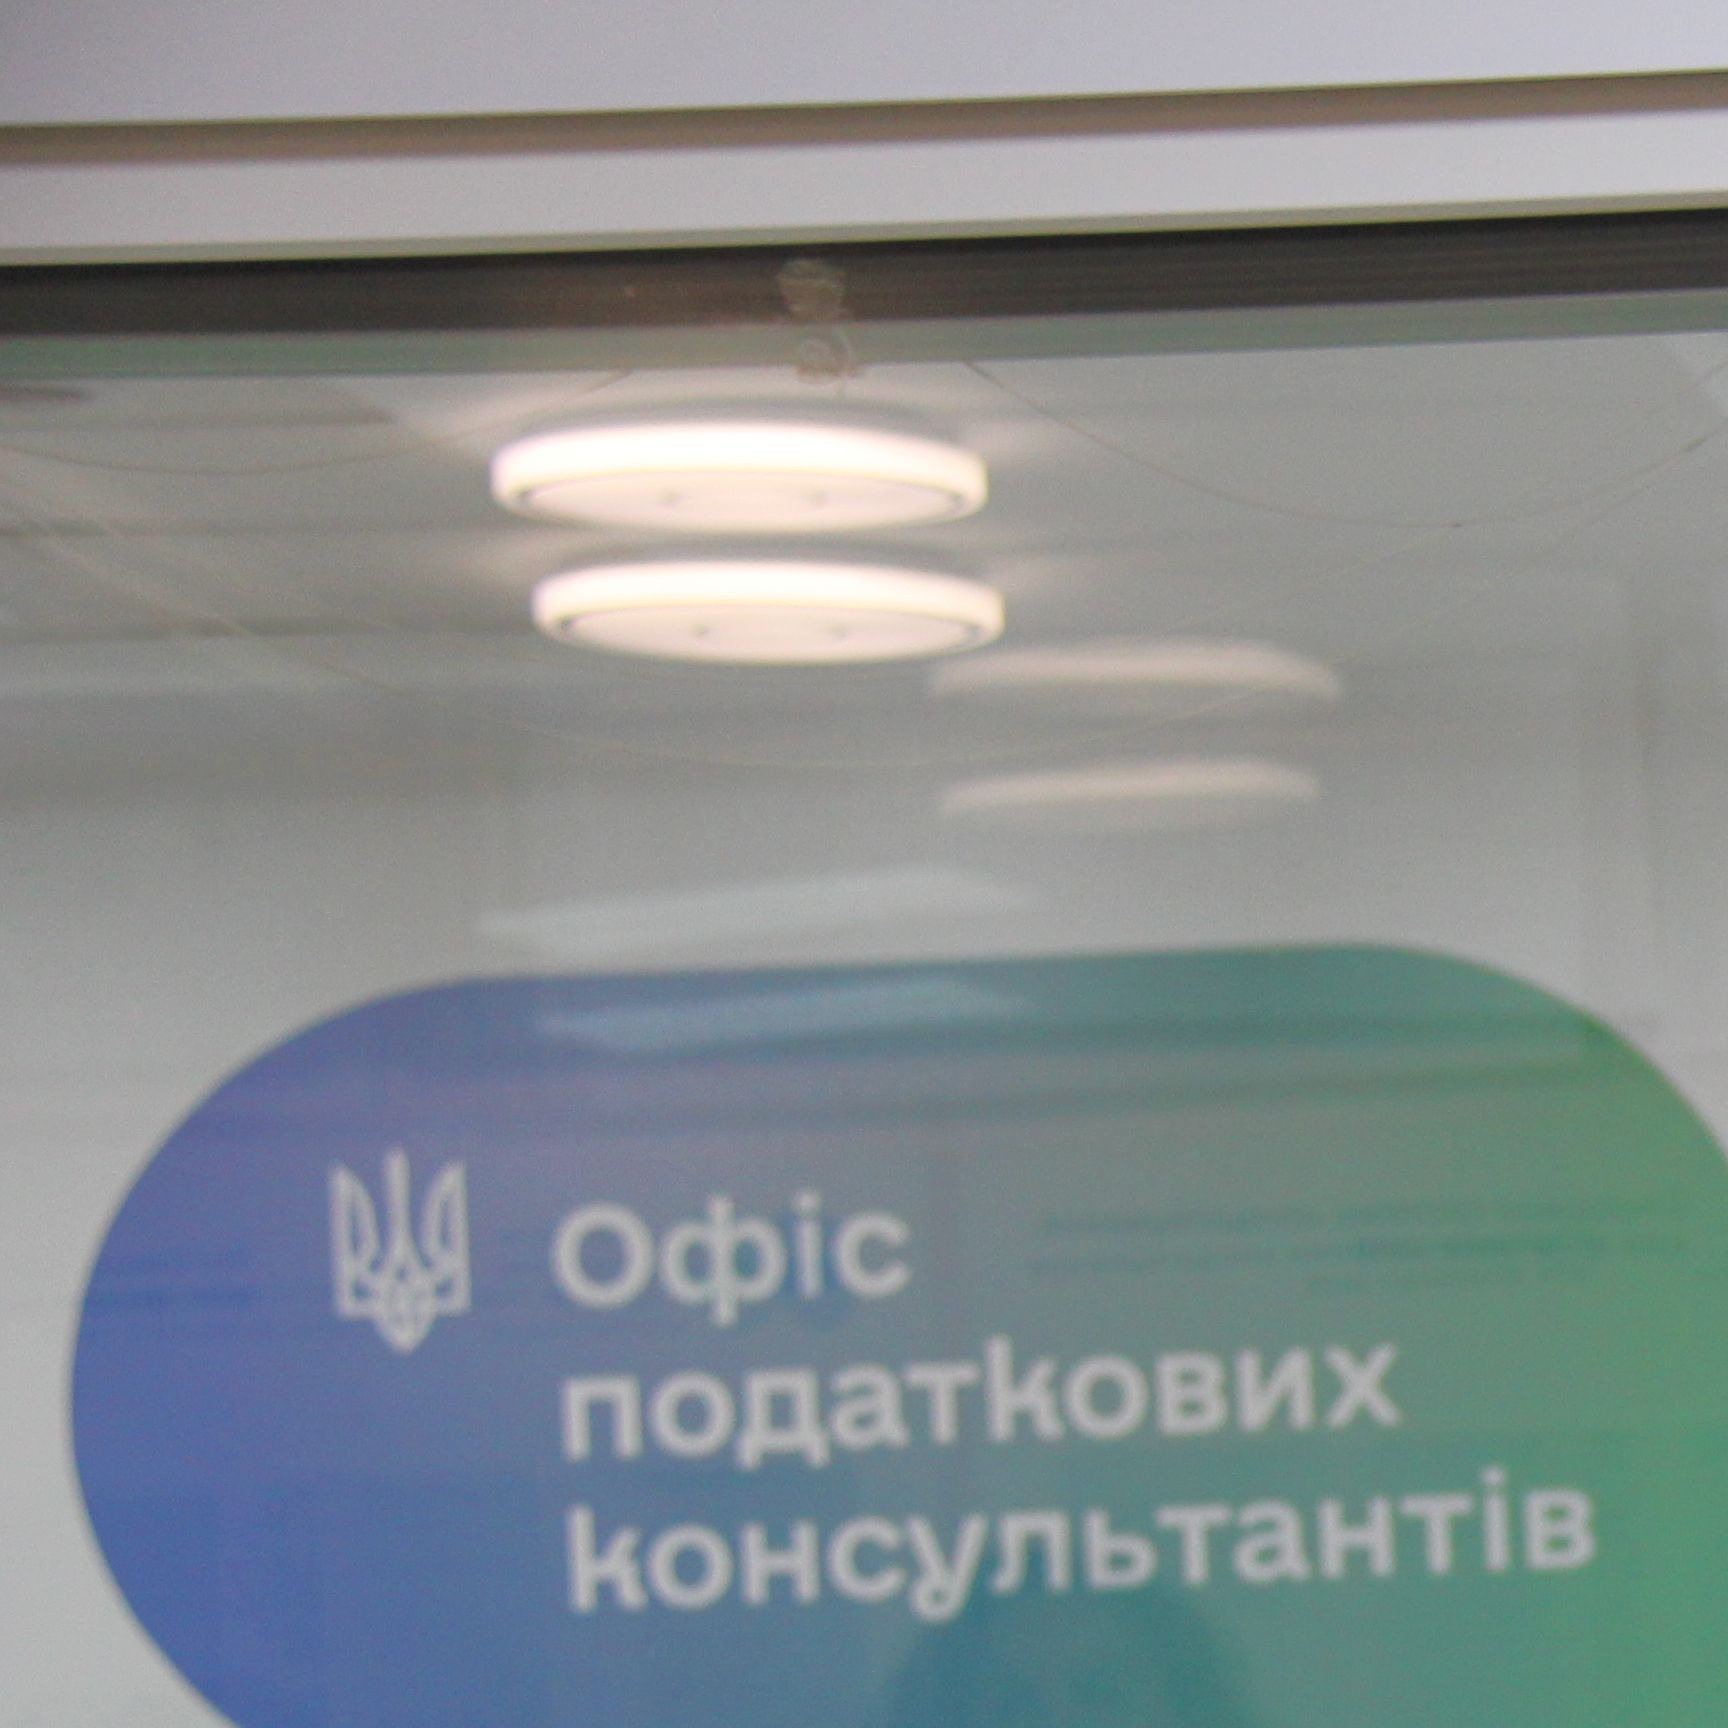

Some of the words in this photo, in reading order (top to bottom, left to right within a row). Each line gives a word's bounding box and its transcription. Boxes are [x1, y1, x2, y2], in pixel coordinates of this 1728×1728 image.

[553, 1191, 911, 1325] Офіс
[562, 1336, 1399, 1467] податкових
[566, 1467, 1596, 1622] консультантів
